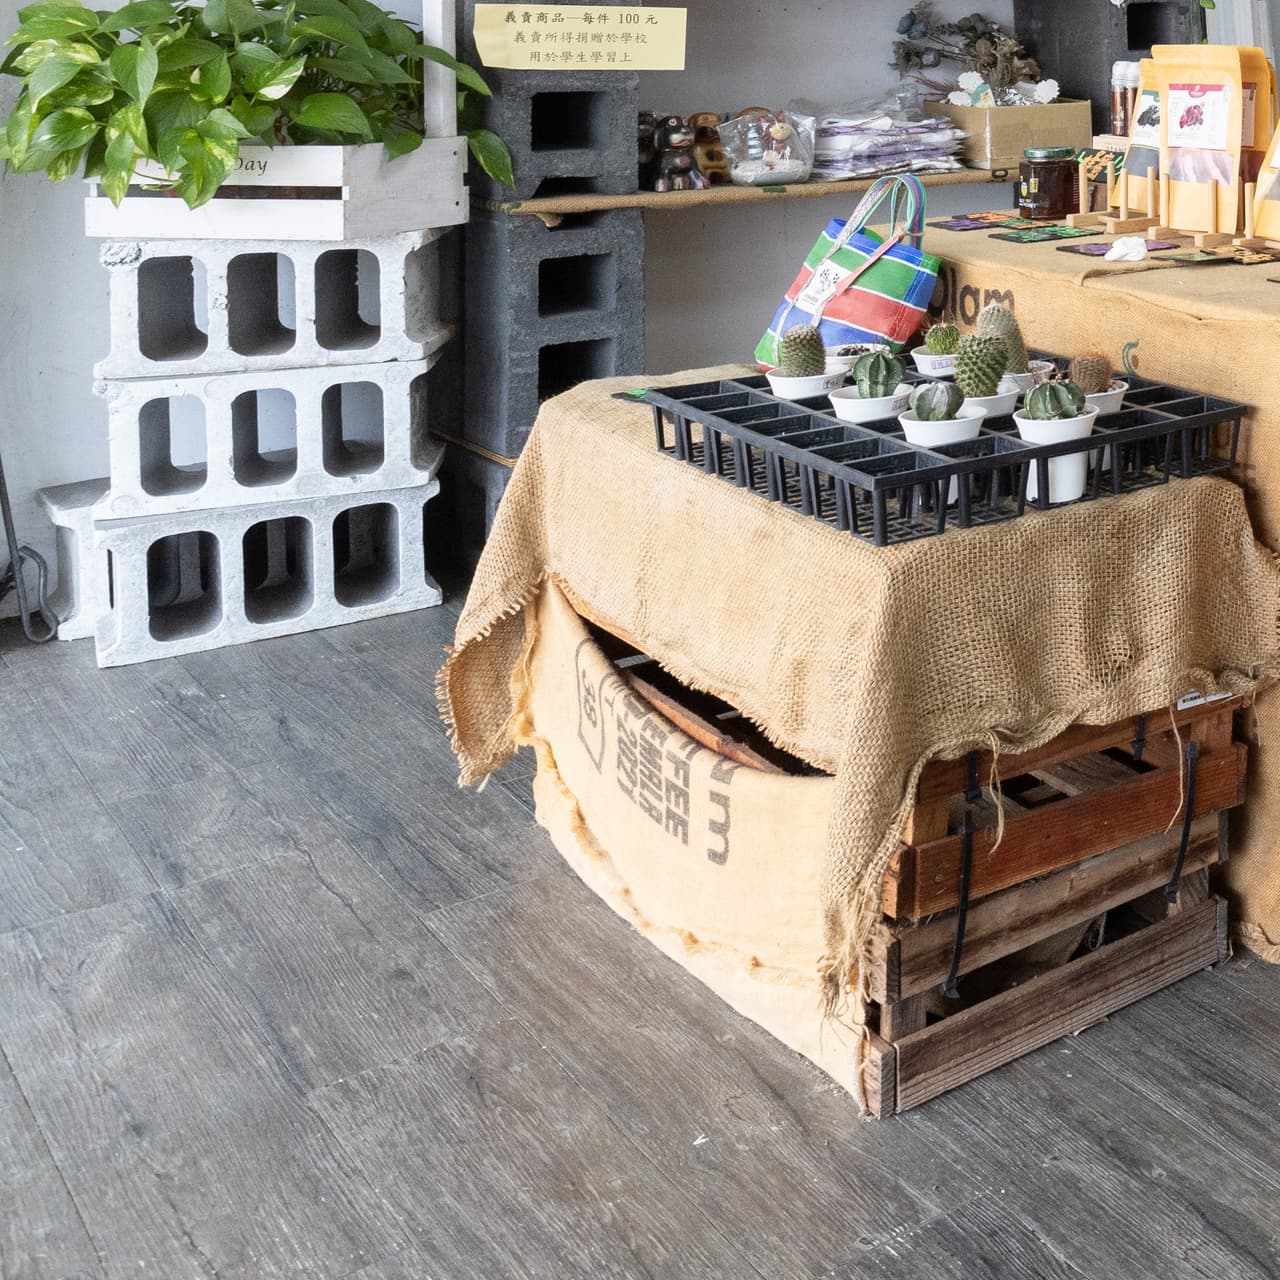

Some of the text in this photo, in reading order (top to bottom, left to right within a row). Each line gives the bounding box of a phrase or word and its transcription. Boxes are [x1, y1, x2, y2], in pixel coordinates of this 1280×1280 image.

[618, 12, 640, 25] 100
[645, 12, 659, 26] 元
[529, 50, 633, 64] 用於學生學習上
